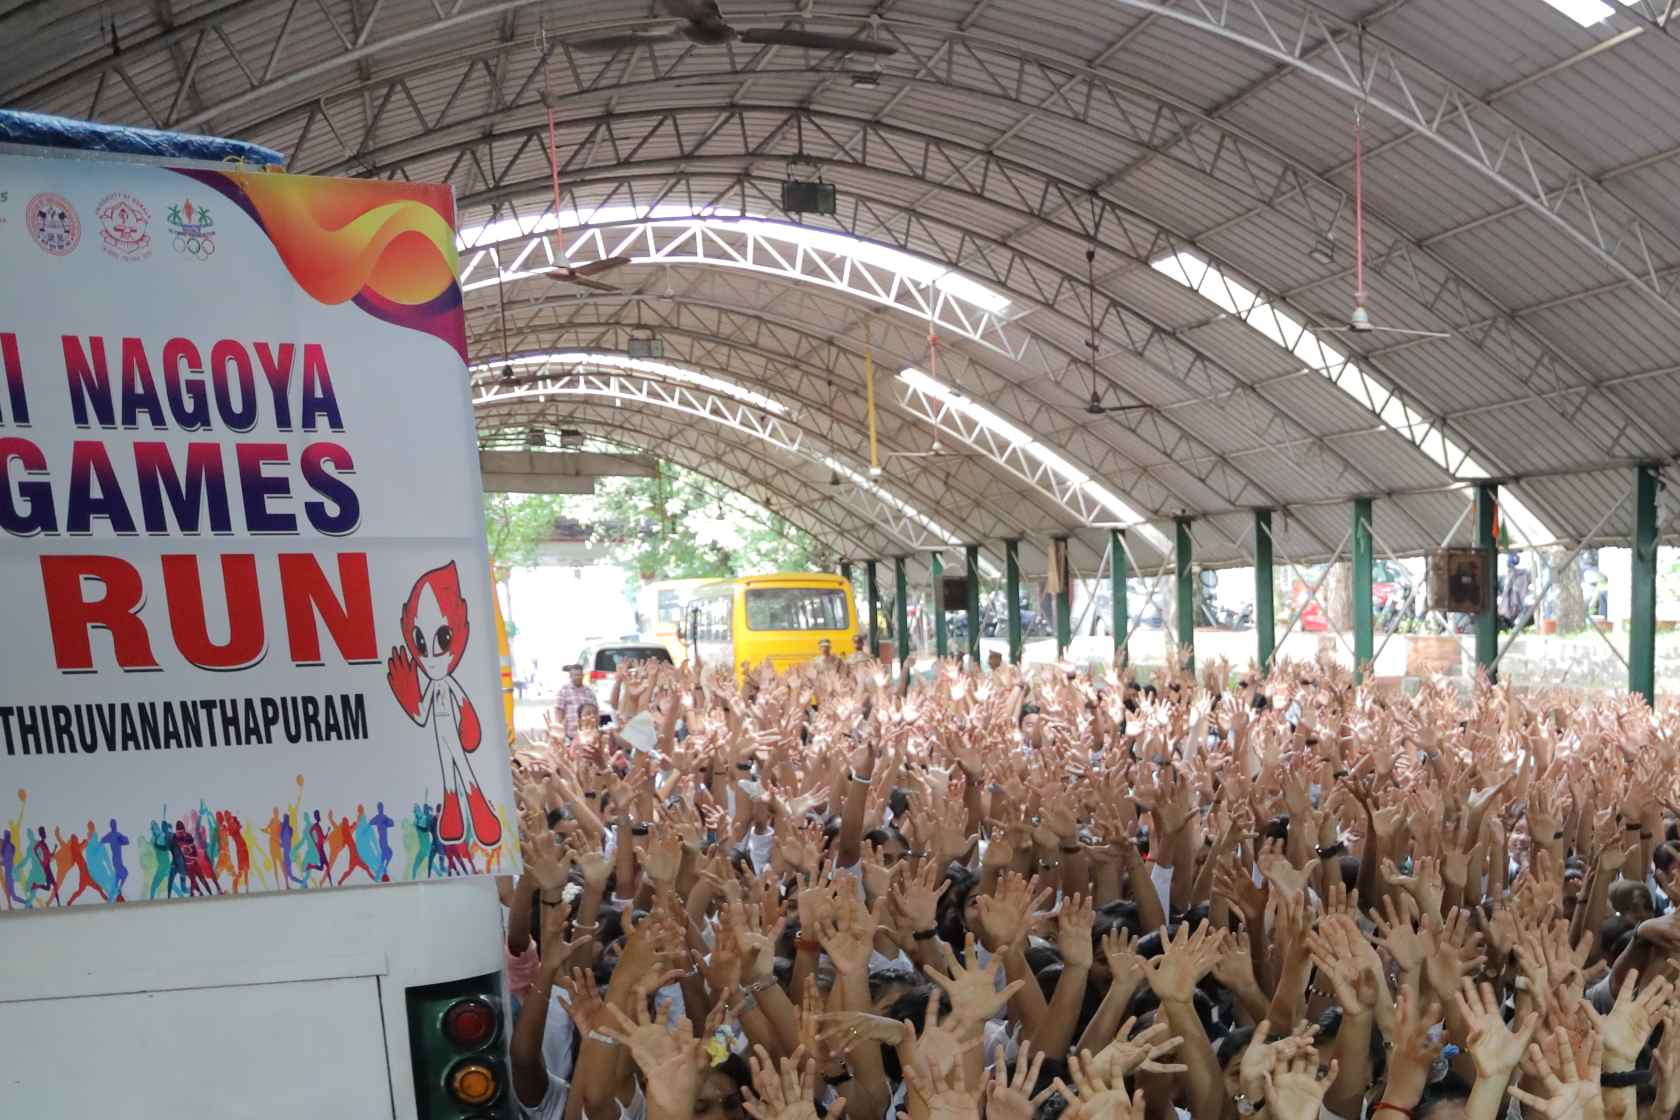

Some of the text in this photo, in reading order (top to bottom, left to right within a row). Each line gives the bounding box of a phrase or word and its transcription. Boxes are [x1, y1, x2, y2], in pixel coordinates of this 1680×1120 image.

[0, 332, 346, 433] I NAGOYA
[0, 436, 363, 537] GAMES
[40, 552, 382, 674] RUN
[0, 693, 369, 756] THIRUVANANTHAPURAM
